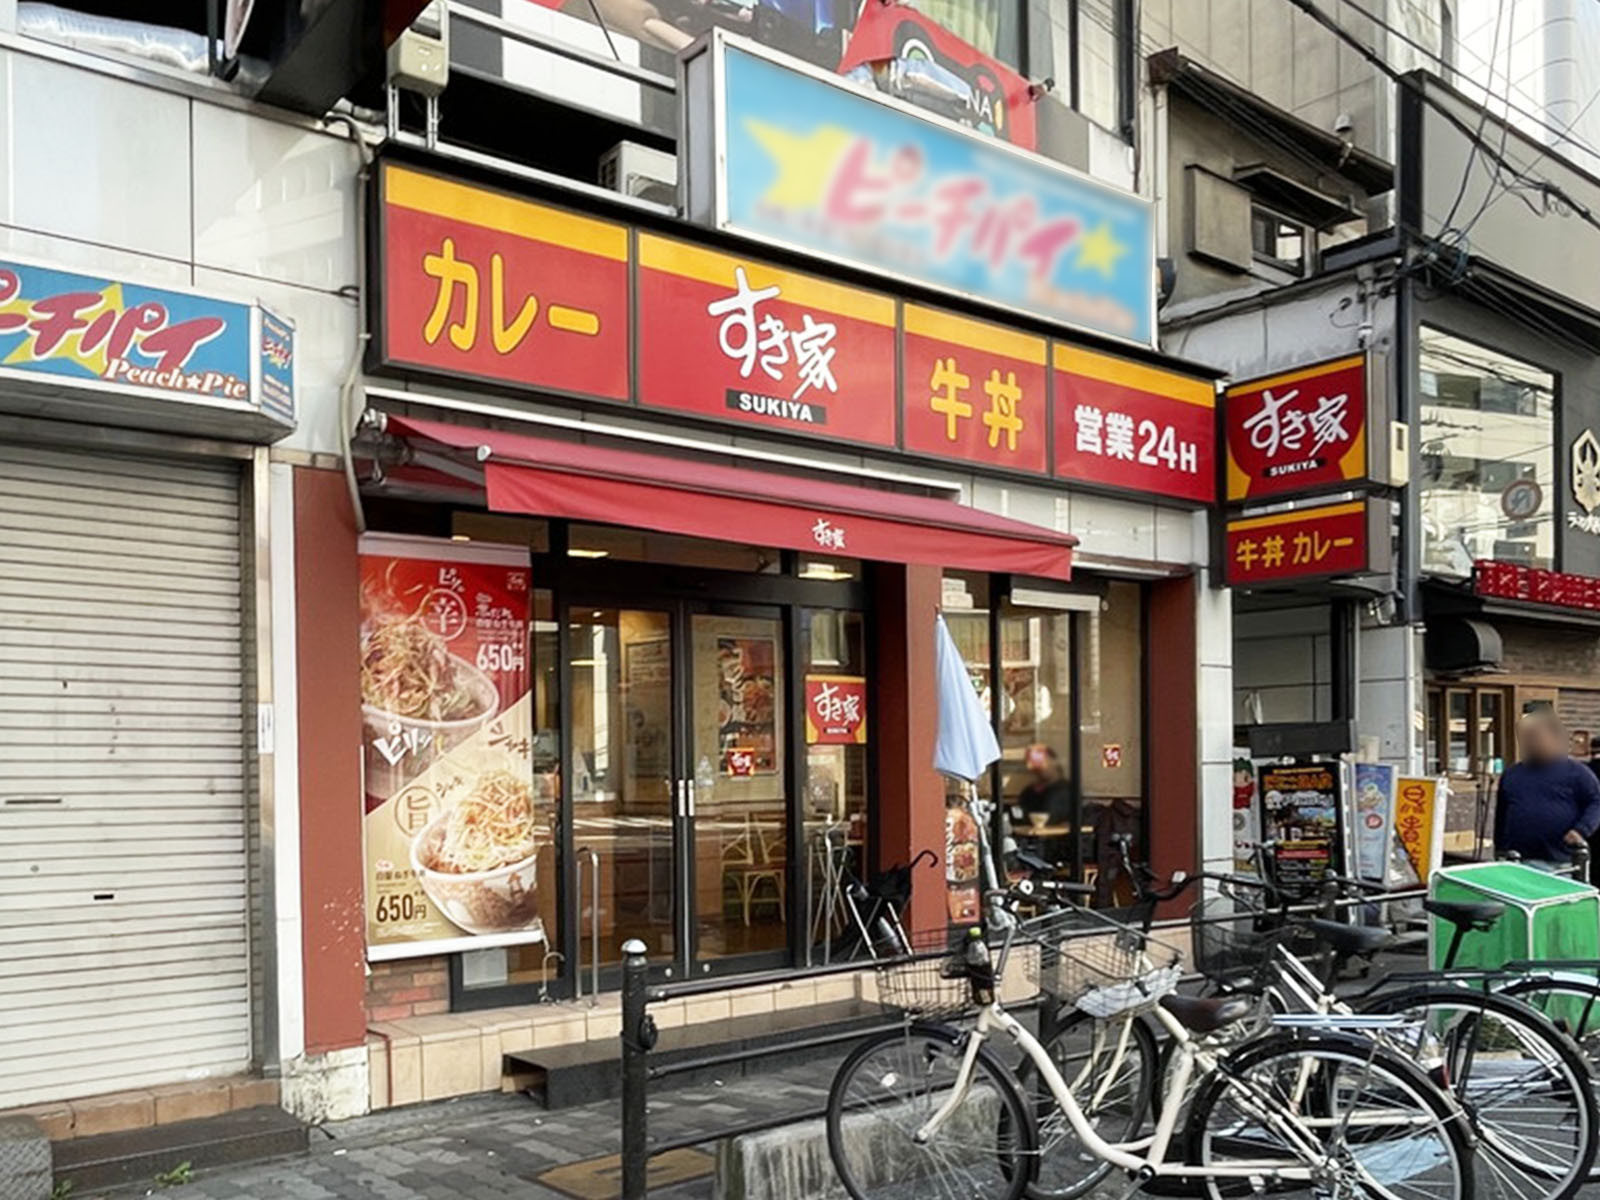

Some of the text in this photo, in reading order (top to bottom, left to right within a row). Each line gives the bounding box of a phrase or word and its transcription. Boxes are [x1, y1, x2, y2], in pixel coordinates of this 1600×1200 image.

[422, 236, 601, 355] カレー
[707, 265, 838, 400] すき家
[738, 392, 814, 422] SUKIYA
[930, 357, 1024, 451] 牛丼
[1242, 389, 1350, 458] すき家
[1270, 459, 1319, 477] SUKIYA
[811, 517, 846, 551] すき家
[1235, 530, 1354, 571] 牛丼 カレー
[812, 682, 861, 728] すき家
[375, 893, 427, 923] 650円
